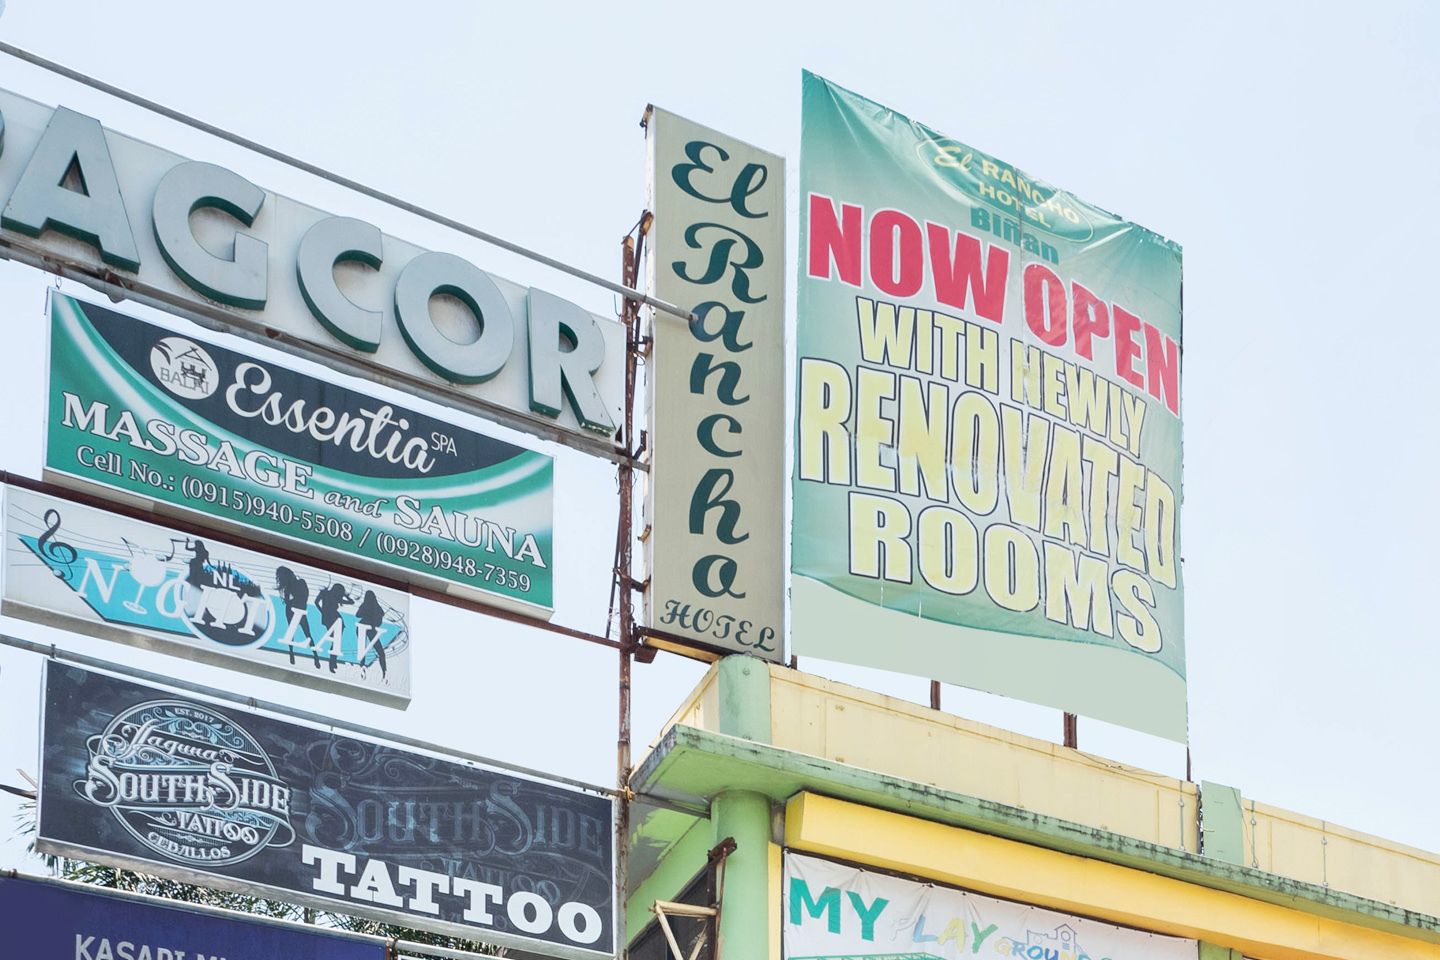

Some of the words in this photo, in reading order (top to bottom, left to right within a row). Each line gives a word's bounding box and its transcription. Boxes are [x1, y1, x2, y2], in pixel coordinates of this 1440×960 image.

[671, 141, 768, 218] El
[980, 182, 1051, 228] HOTEL
[0, 104, 618, 437] AGCOR
[808, 193, 1010, 324] NOW
[1023, 263, 1180, 418] OPEN
[226, 362, 436, 473] Essentia
[431, 432, 458, 457] SPA
[856, 296, 999, 395] WITH
[1010, 337, 1147, 459] NEWLY
[62, 392, 314, 499] MASSAGE
[324, 489, 388, 518] and
[394, 494, 546, 569] SAUNA
[76, 444, 121, 473] Cell
[129, 461, 175, 492] No.:
[181, 475, 353, 542] (0915)940-5508
[376, 532, 531, 593] (0928)948-7359
[800, 357, 1177, 590] RENOVATED
[213, 572, 240, 590] NL
[849, 491, 1163, 653] ROOMS
[660, 599, 776, 653] HOTEL
[174, 708, 190, 717] EST.
[194, 711, 214, 723] 2017
[176, 811, 259, 845] TATTOO
[301, 844, 602, 944] TATTOO
[789, 876, 889, 942] MY
